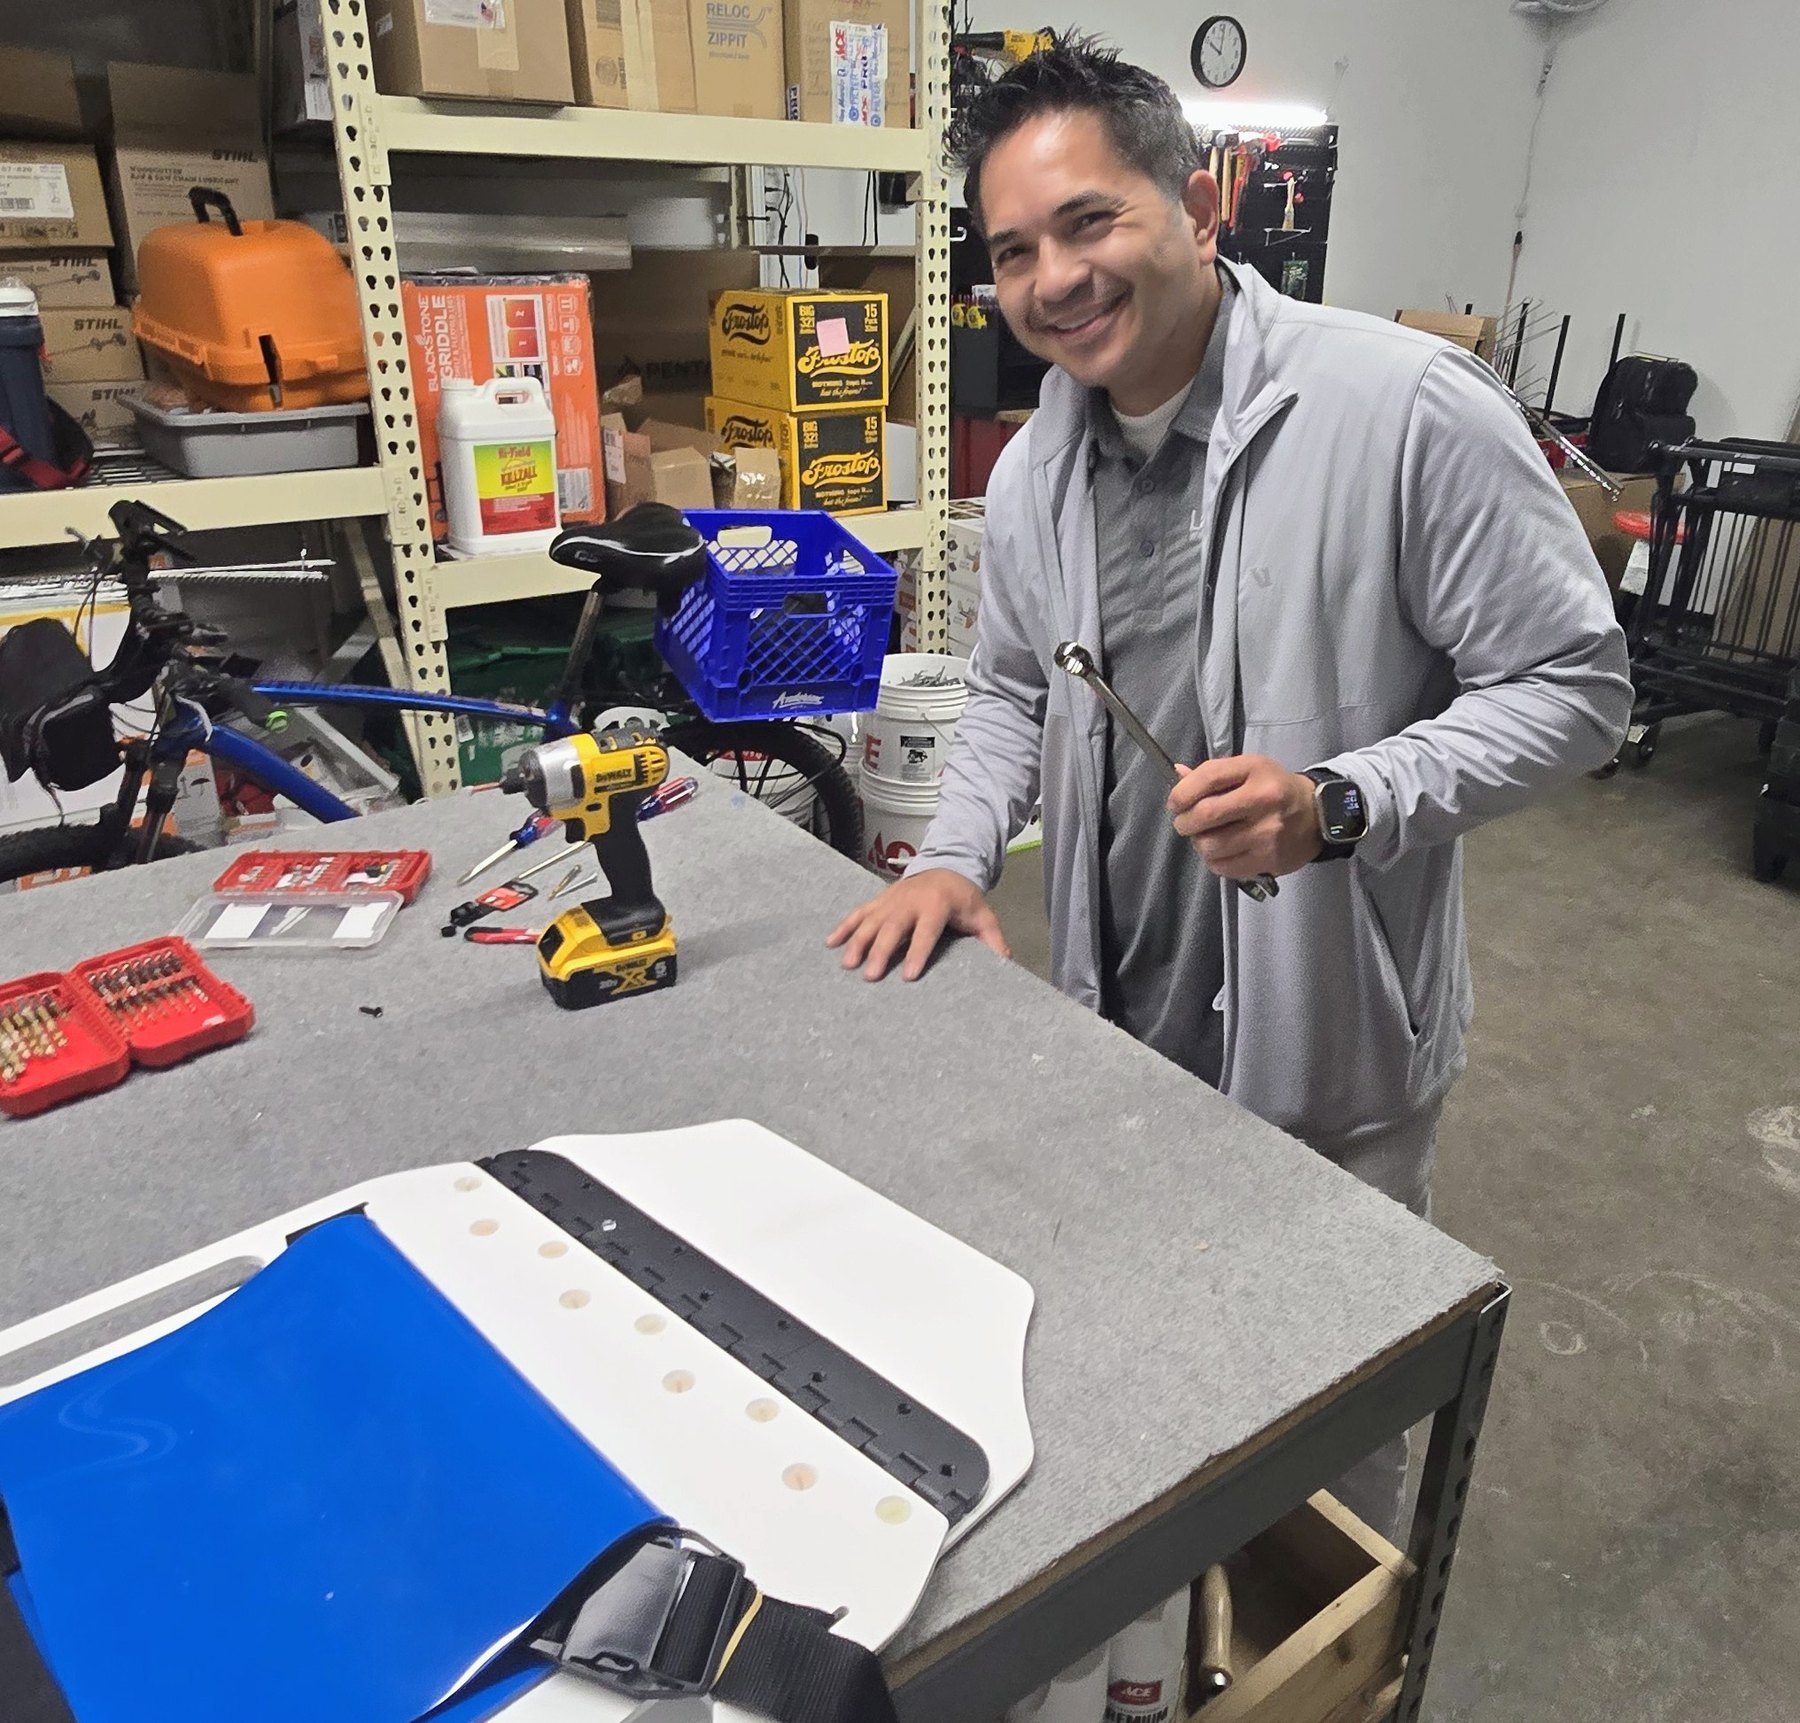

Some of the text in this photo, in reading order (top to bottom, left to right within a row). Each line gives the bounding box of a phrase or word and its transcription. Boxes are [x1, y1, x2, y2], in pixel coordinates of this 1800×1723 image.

[707, 31, 748, 48] ZIPPIT
[211, 148, 259, 163] STIHL
[49, 256, 98, 267] STIHL
[864, 303, 878, 318] 15
[73, 318, 123, 331] STIHL
[721, 303, 772, 345] Frostop
[417, 293, 439, 393] BLACKSTONE
[431, 295, 454, 379] GRIDDLE
[864, 416, 878, 430] 15
[720, 415, 776, 448] Frostop
[801, 449, 881, 489] Frostop
[1120, 1685, 1153, 1697] ACE
